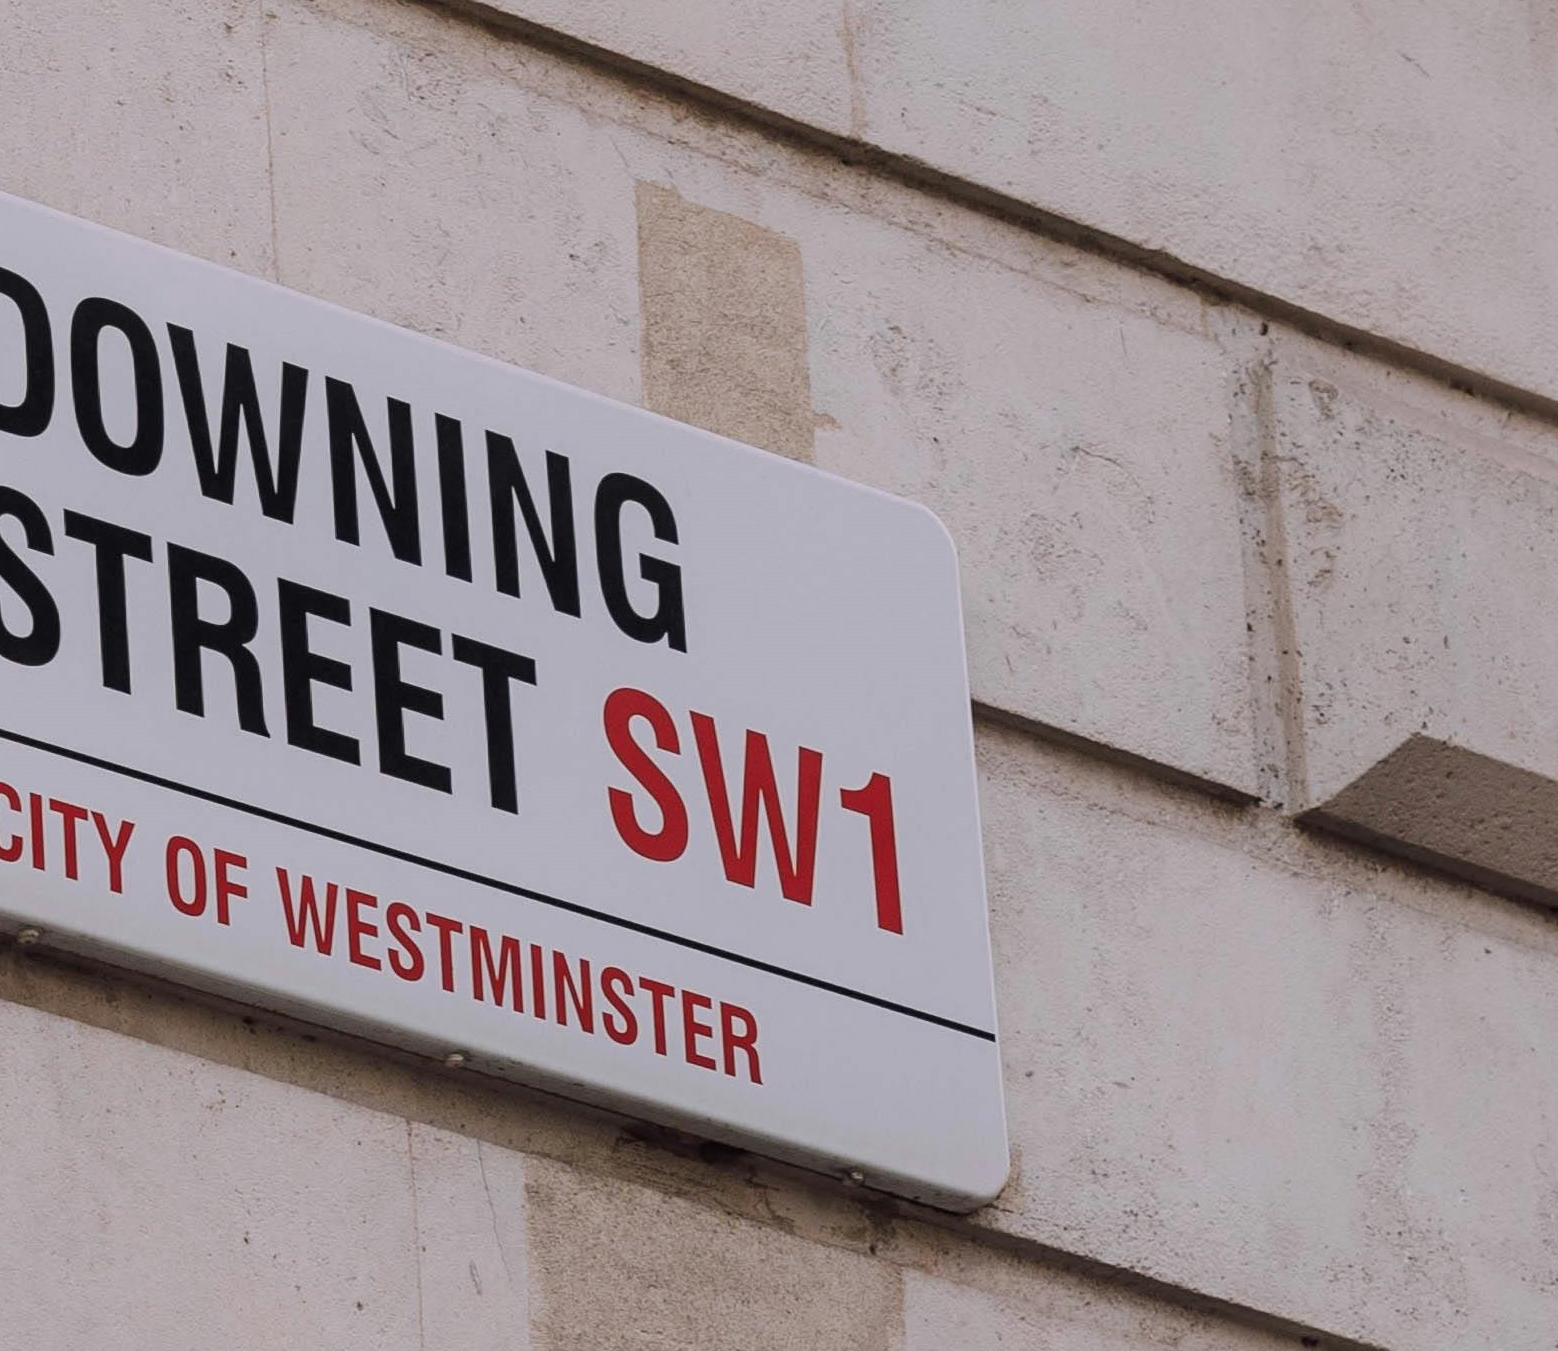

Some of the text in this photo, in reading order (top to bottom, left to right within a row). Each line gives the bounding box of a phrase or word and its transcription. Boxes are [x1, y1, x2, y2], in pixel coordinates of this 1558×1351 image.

[602, 687, 905, 934] SW1
[165, 835, 248, 925] OF
[276, 867, 761, 1083] WESTMINSTER
